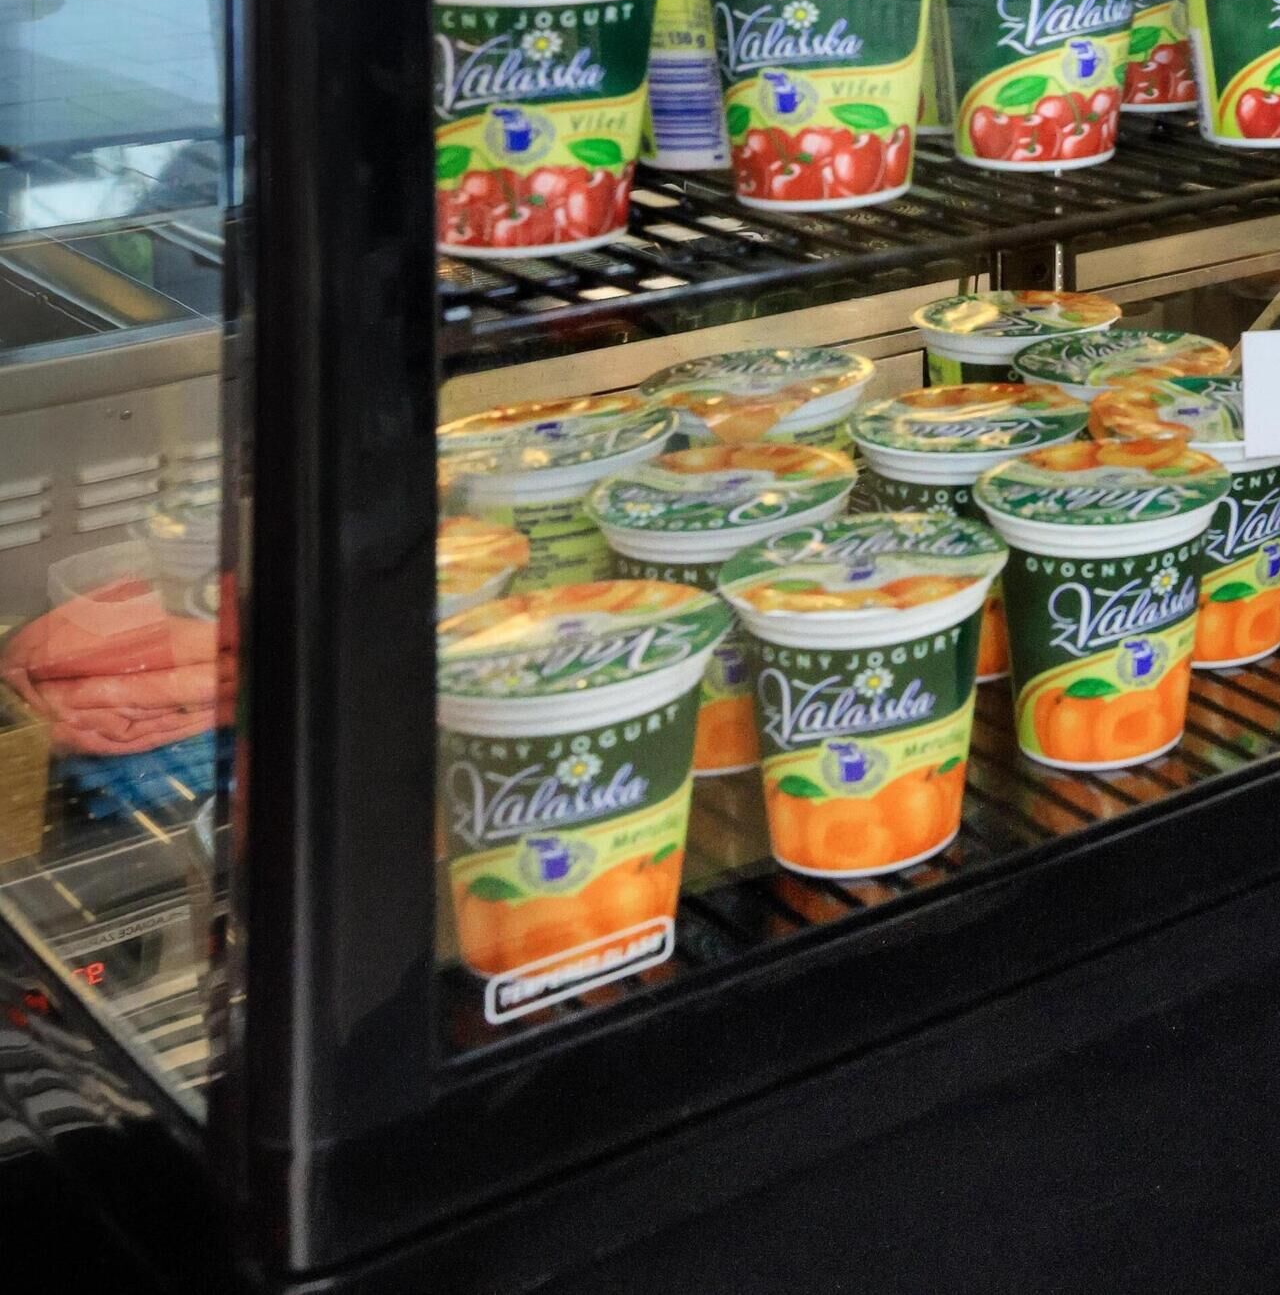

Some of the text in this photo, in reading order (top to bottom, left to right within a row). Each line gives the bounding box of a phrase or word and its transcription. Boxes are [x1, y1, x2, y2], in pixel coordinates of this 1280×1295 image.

[513, 3, 634, 30] JOGURT
[846, 626, 963, 671] JOGURT
[547, 703, 679, 759] JOGURT
